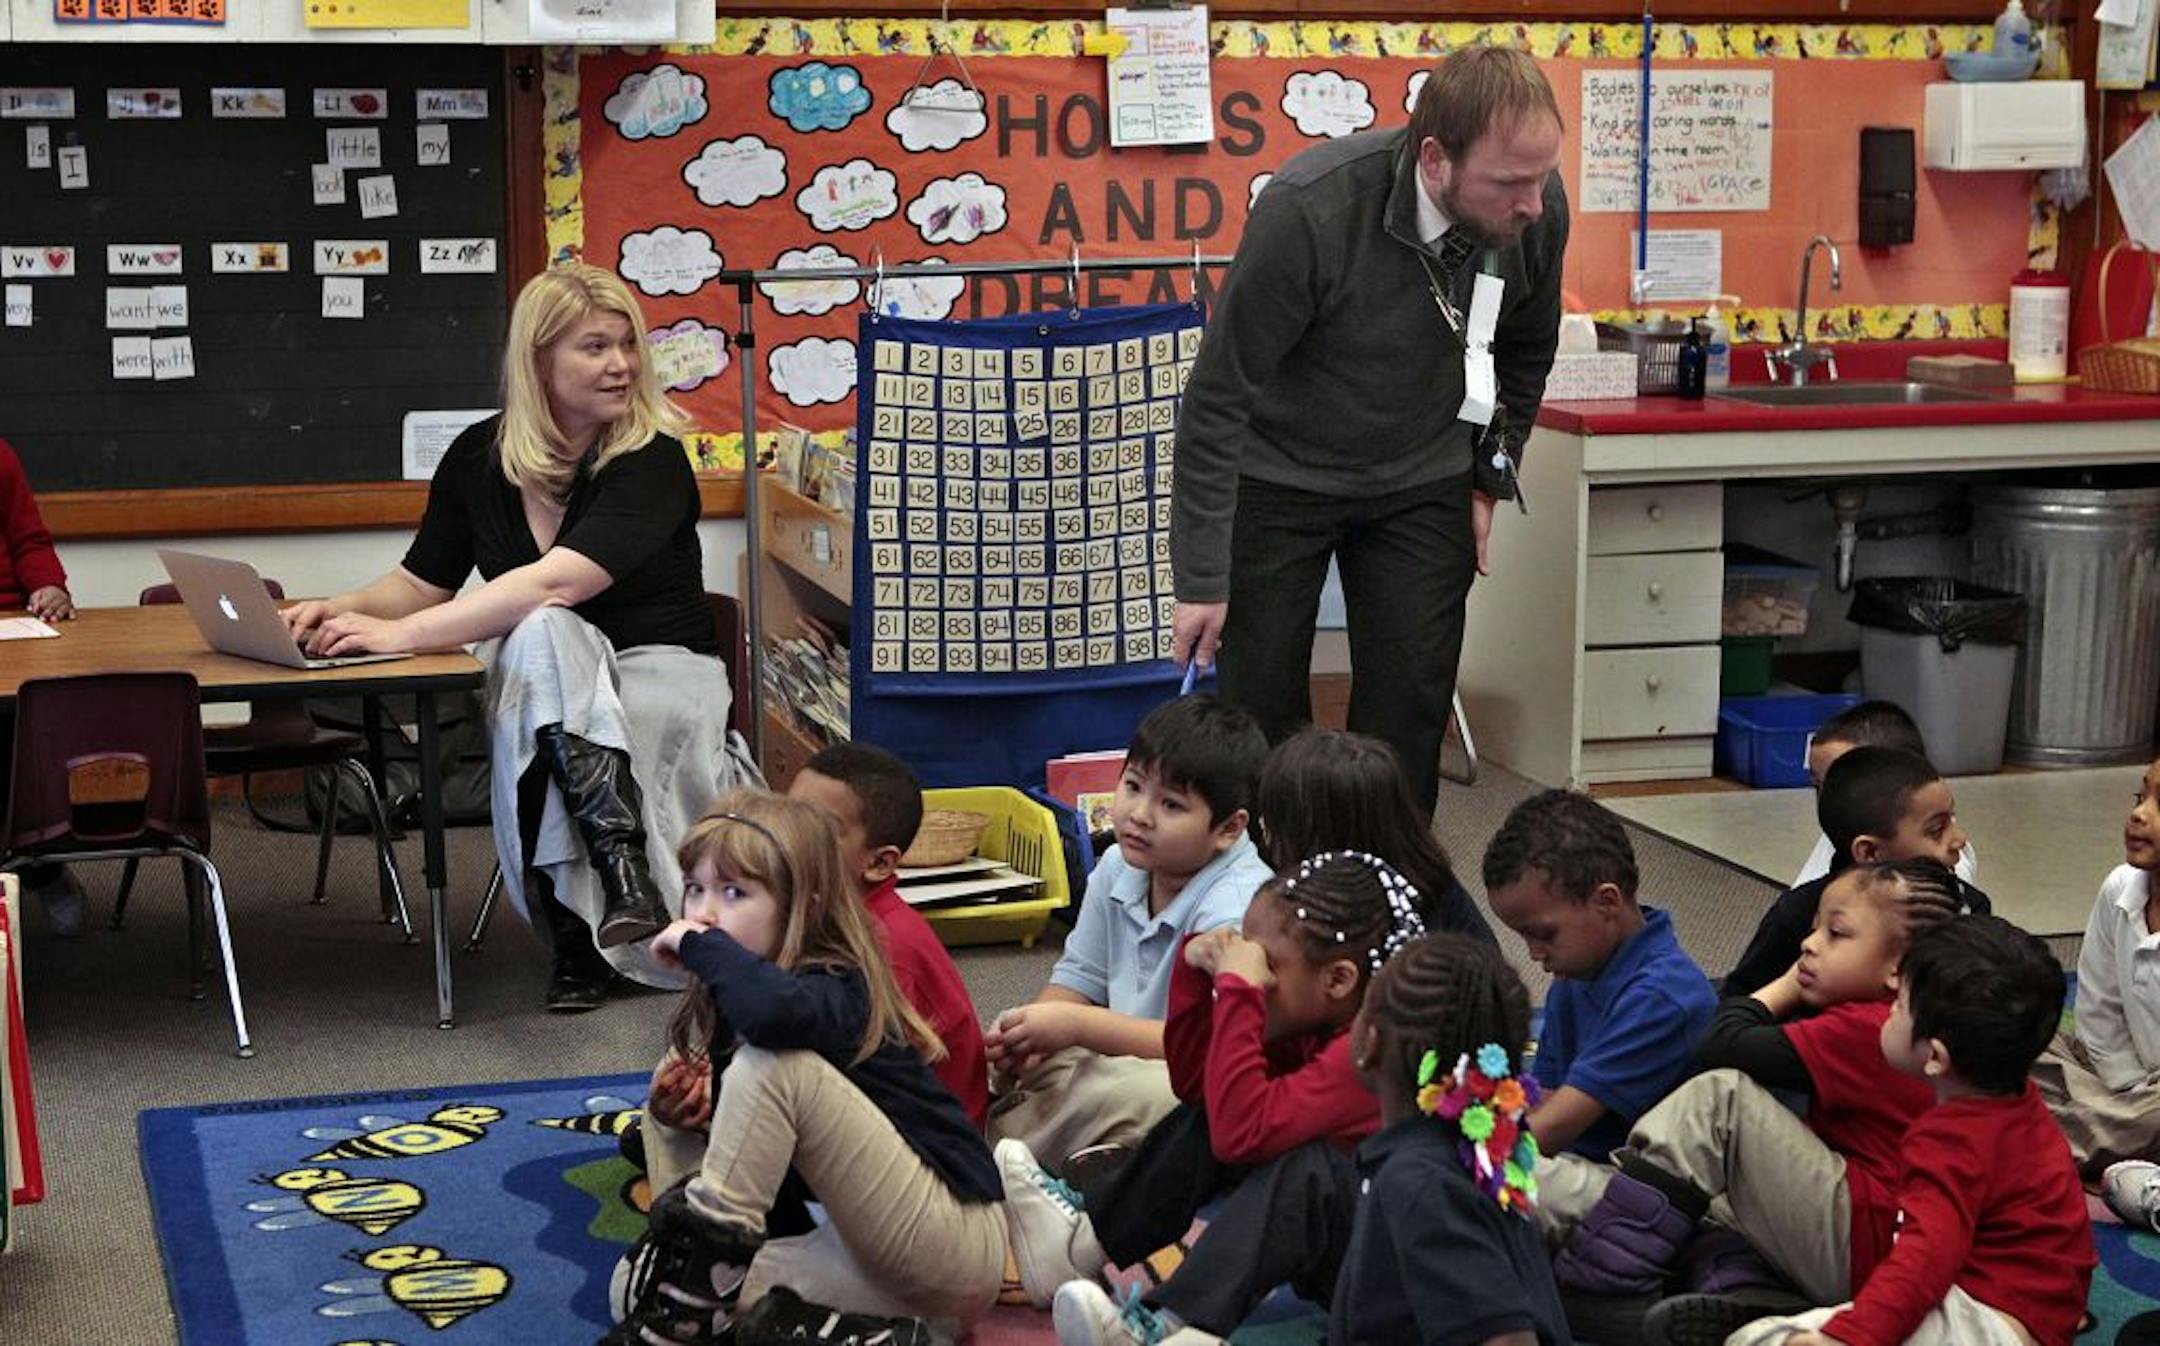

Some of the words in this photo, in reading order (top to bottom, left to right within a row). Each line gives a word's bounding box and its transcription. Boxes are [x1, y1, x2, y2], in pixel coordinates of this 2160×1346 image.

[1590, 78, 1635, 97] Bodies
[119, 93, 133, 114] Jj
[222, 96, 245, 110] Kk
[428, 97, 457, 111] Mm
[998, 91, 1266, 158] HOS
[1590, 113, 1618, 131] Kind
[1653, 116, 1693, 135] caring
[32, 138, 46, 157] is
[331, 135, 376, 158] little
[422, 141, 448, 160] my
[1590, 143, 1639, 160] Walking
[1664, 141, 1688, 156] the
[64, 154, 81, 177] I
[363, 185, 393, 208] like
[1039, 175, 1224, 244] AND
[13, 255, 34, 268] Vv
[119, 252, 149, 266] Ww
[225, 251, 247, 265] Xx
[324, 247, 344, 264] Yy
[429, 246, 449, 260] Zz
[109, 296, 153, 318] want
[158, 303, 183, 316] we
[326, 294, 353, 314] you
[116, 352, 148, 368] were
[153, 346, 191, 369] with
[918, 350, 930, 369] 2
[951, 353, 963, 372] 3
[983, 355, 996, 373] 4
[1022, 354, 1034, 373] 5
[1063, 353, 1074, 372] 6
[1093, 350, 1105, 369] 7
[1125, 346, 1135, 364] 8
[1156, 340, 1166, 359] 9
[1183, 333, 1199, 353] 10
[884, 380, 897, 398] 11
[911, 383, 928, 401] 12
[948, 386, 965, 404] 13
[982, 386, 1001, 404] 14
[1022, 387, 1039, 406] 15
[1055, 386, 1072, 404] 16
[1094, 384, 1110, 400] 17
[1124, 375, 1139, 395] 18
[1158, 367, 1171, 389] 19
[1181, 367, 1190, 384] 2
[879, 414, 899, 432] 21
[911, 416, 934, 435] 22
[946, 418, 969, 437] 23
[979, 419, 1004, 437] 24
[1019, 413, 1044, 435] 25
[1055, 418, 1078, 437] 26
[1092, 415, 1114, 434] 27
[1125, 411, 1145, 430] 28
[1152, 406, 1171, 426] 29
[873, 447, 893, 467] 31
[909, 450, 932, 469] 32
[943, 452, 970, 473] 33
[983, 454, 1008, 473] 34
[1017, 454, 1042, 473] 35
[1055, 451, 1078, 471] 36
[1091, 448, 1113, 468] 37
[1122, 445, 1142, 464] 38
[875, 482, 894, 500] 41
[907, 482, 934, 501] 42
[949, 486, 972, 506] 43
[982, 489, 1007, 504] 44
[1021, 486, 1046, 504] 45
[1055, 481, 1078, 505] 46
[1090, 481, 1113, 499] 47
[1122, 476, 1144, 493] 48
[873, 515, 893, 534] 51
[911, 516, 934, 535] 52
[950, 517, 974, 537] 53
[985, 519, 1010, 536] 54
[1019, 518, 1042, 536] 55
[1058, 515, 1080, 534] 56
[1093, 511, 1114, 532] 57
[1124, 508, 1145, 527] 58
[877, 548, 897, 567] 61
[913, 551, 937, 568] 62
[949, 551, 972, 569] 63
[985, 551, 1009, 571] 64
[1019, 550, 1042, 568] 65
[1059, 548, 1082, 567] 66
[1088, 543, 1113, 566] 67
[1120, 540, 1142, 559] 68
[880, 582, 899, 601] 71
[913, 584, 936, 602] 72
[947, 584, 971, 602] 73
[985, 584, 1010, 601] 74
[1022, 583, 1045, 602] 75
[1057, 581, 1079, 598] 76
[1091, 576, 1114, 596] 77
[1125, 572, 1147, 591] 78
[877, 615, 897, 635] 81
[912, 616, 936, 635] 82
[947, 618, 971, 635] 83
[984, 616, 1009, 635] 84
[1018, 616, 1042, 634] 85
[1055, 614, 1078, 633] 86
[1090, 608, 1112, 629] 87
[1126, 605, 1150, 625] 88
[877, 648, 897, 666] 91
[912, 648, 935, 666] 92
[949, 648, 972, 667] 93
[984, 648, 1008, 667] 94
[1020, 648, 1044, 665] 95
[1058, 644, 1080, 663] 96
[1090, 642, 1112, 661] 97
[1128, 637, 1150, 657] 98
